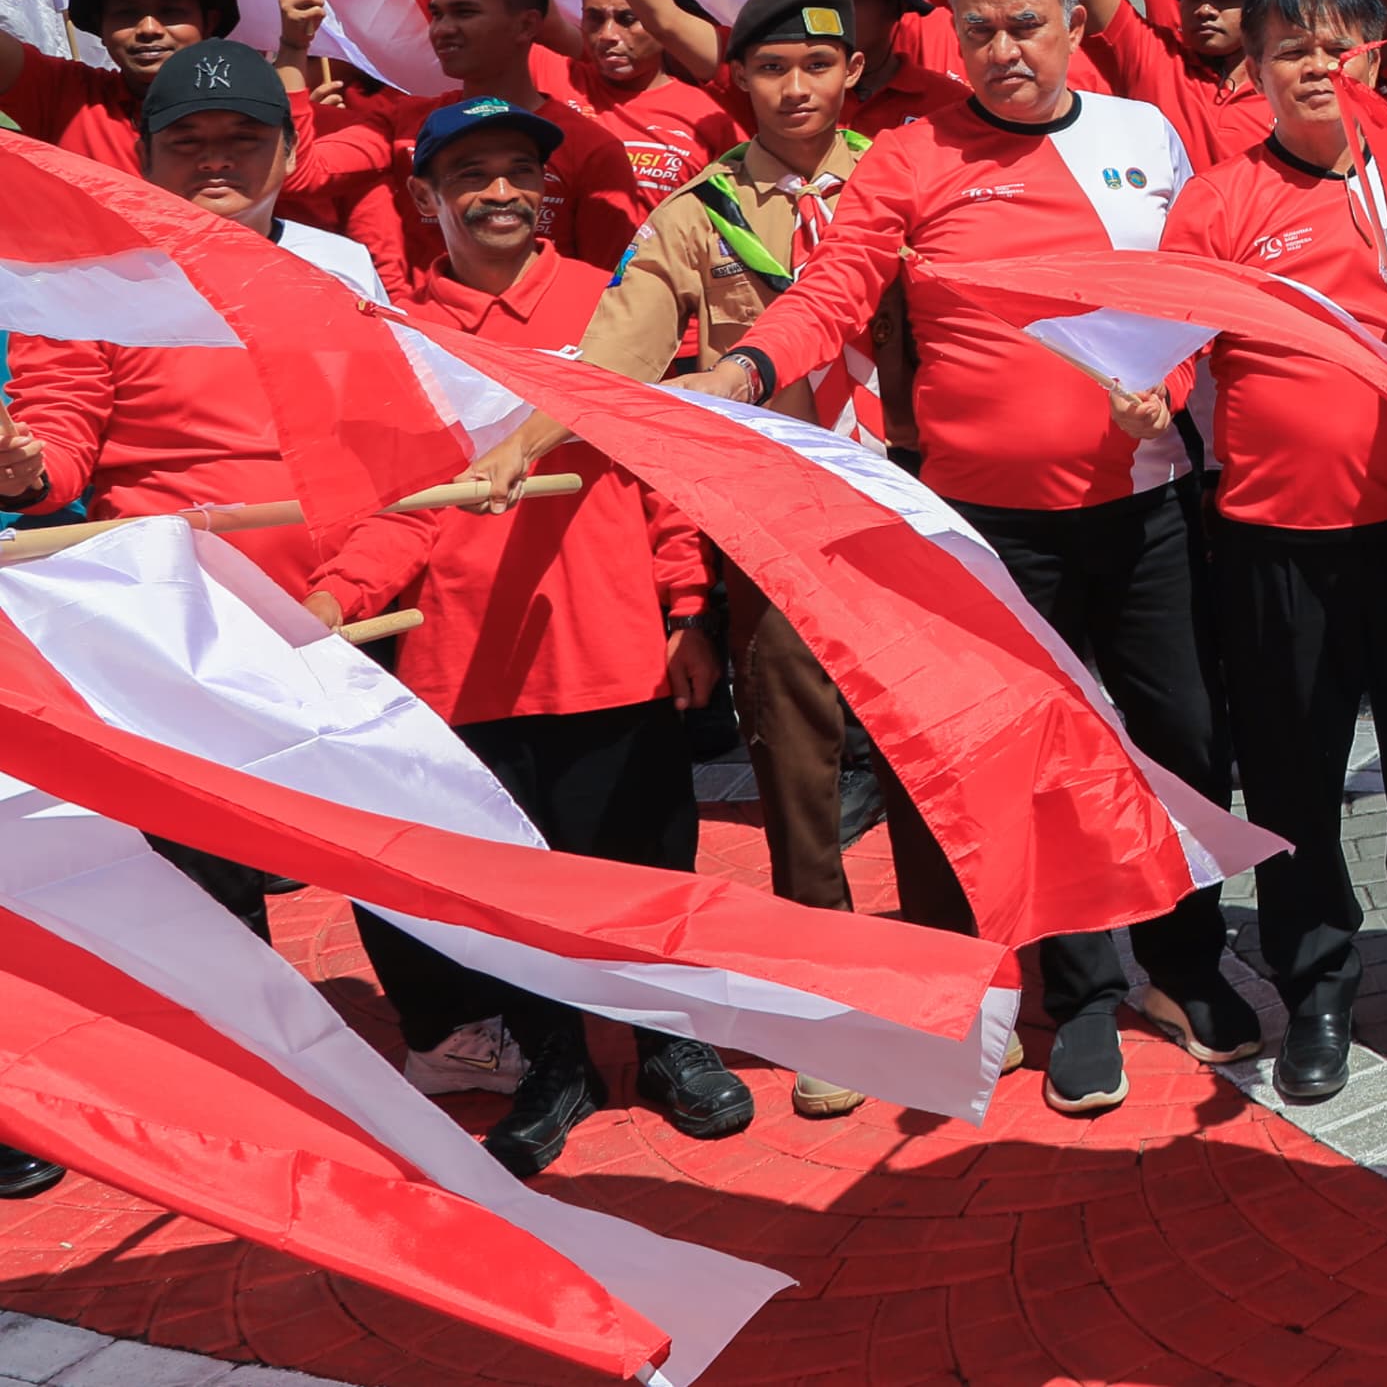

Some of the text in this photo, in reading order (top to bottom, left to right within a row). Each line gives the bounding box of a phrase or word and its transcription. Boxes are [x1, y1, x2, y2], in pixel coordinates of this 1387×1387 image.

[663, 152, 683, 172] 79
[639, 166, 679, 182] MDPL
[1253, 234, 1283, 261] 79
